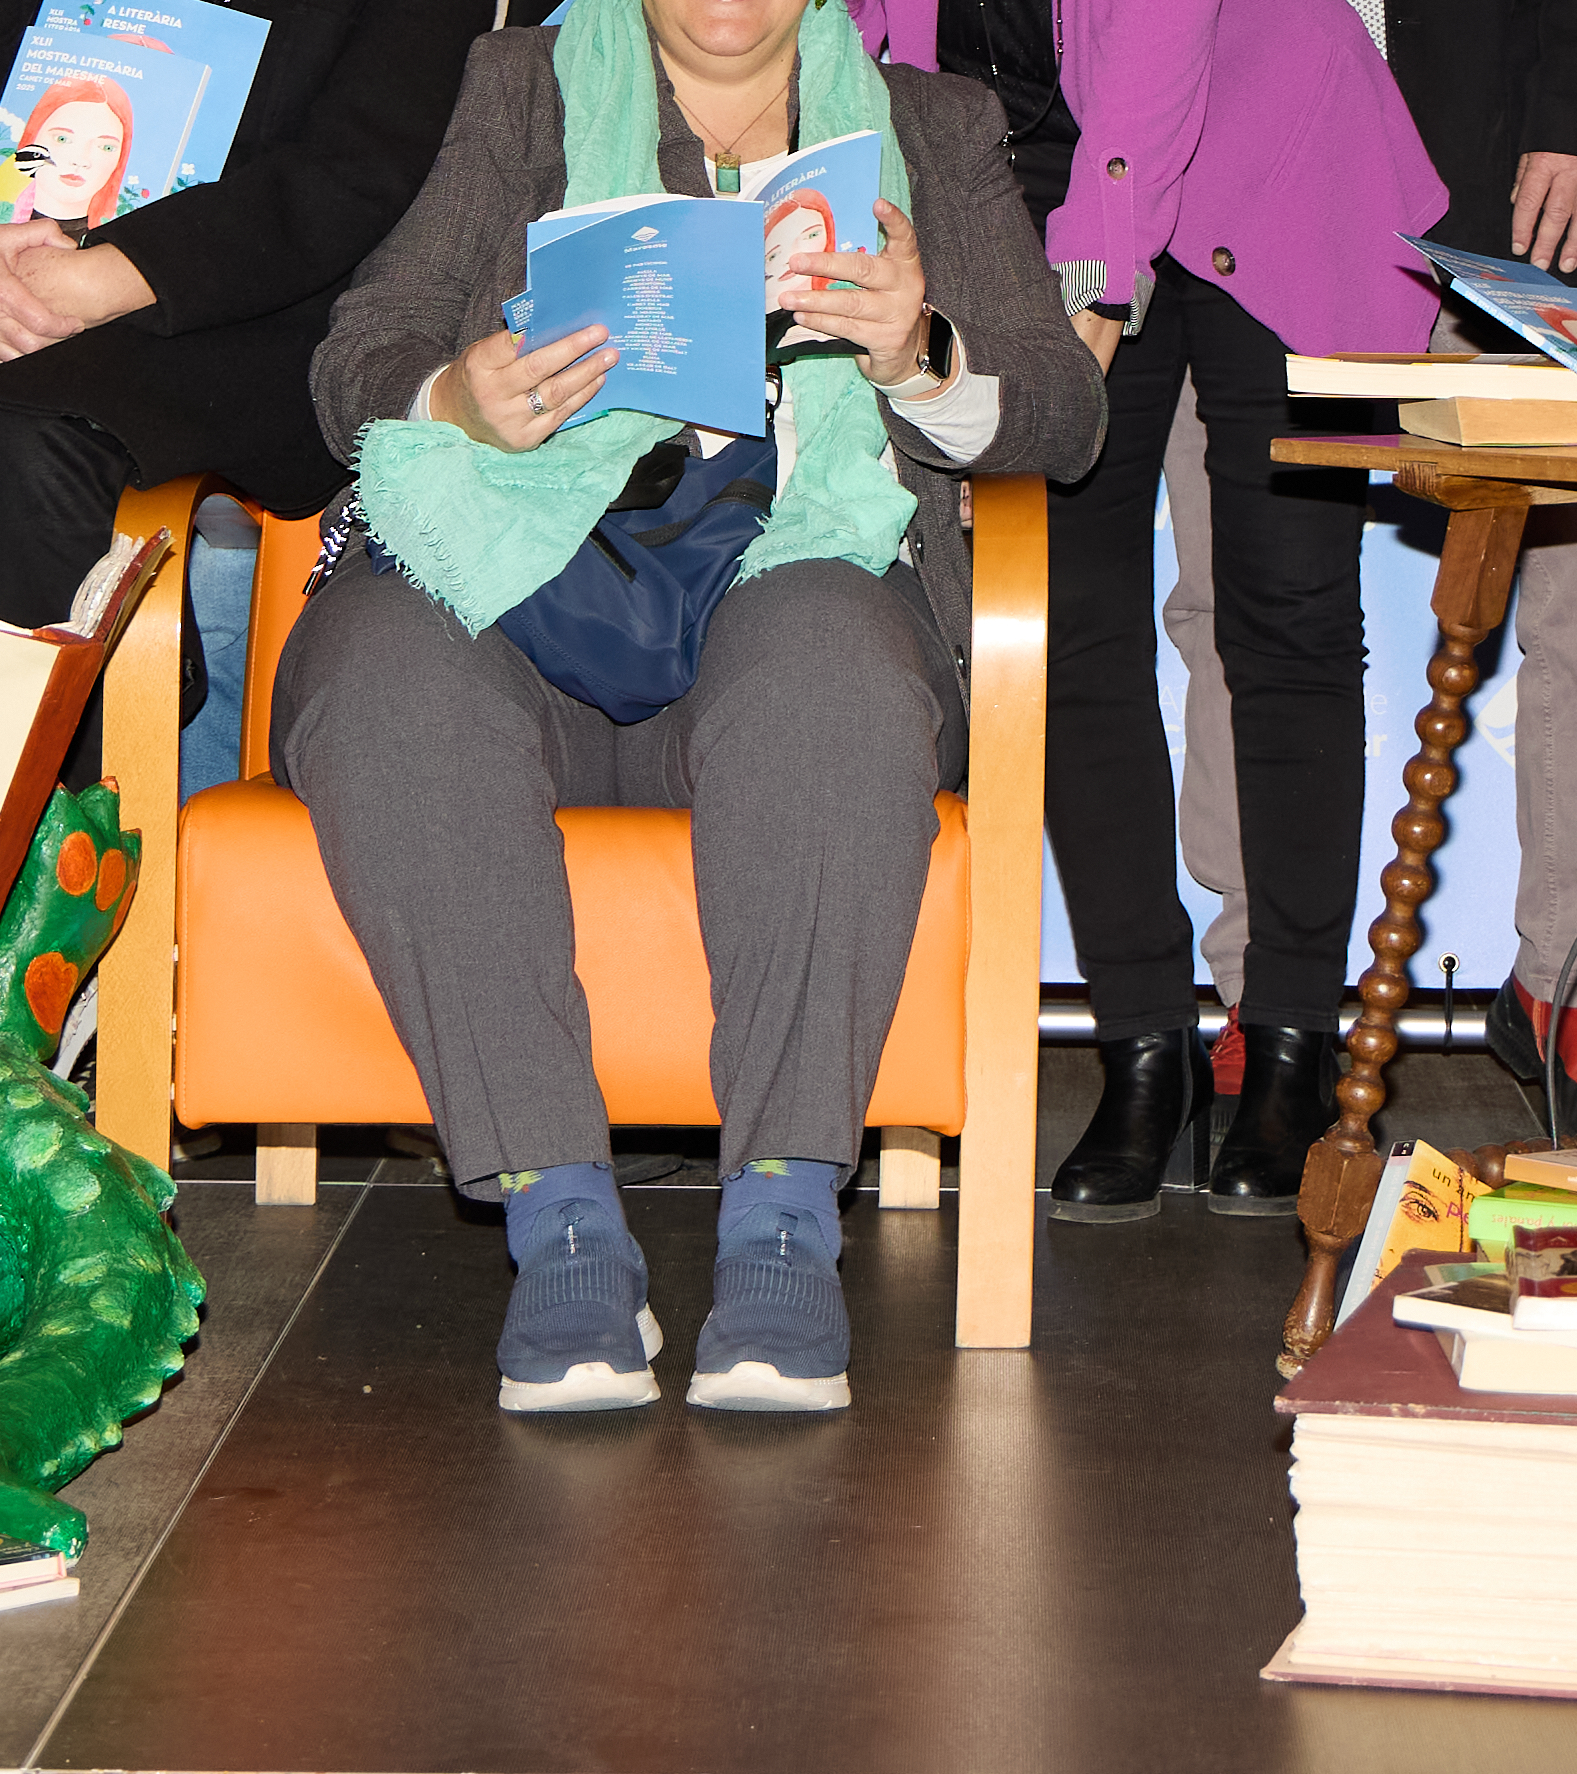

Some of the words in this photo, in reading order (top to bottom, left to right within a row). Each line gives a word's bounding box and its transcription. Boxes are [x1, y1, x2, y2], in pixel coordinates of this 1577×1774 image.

[103, 17, 147, 35] RESME
[118, 6, 183, 29] LITERÀRIA
[30, 35, 53, 47] XLII
[22, 61, 44, 74] DEL
[45, 65, 106, 85] MARESME
[25, 48, 78, 66] MOSTRA
[79, 55, 144, 80] LITERÀRIA
[771, 166, 827, 202] LITERÀRIA
